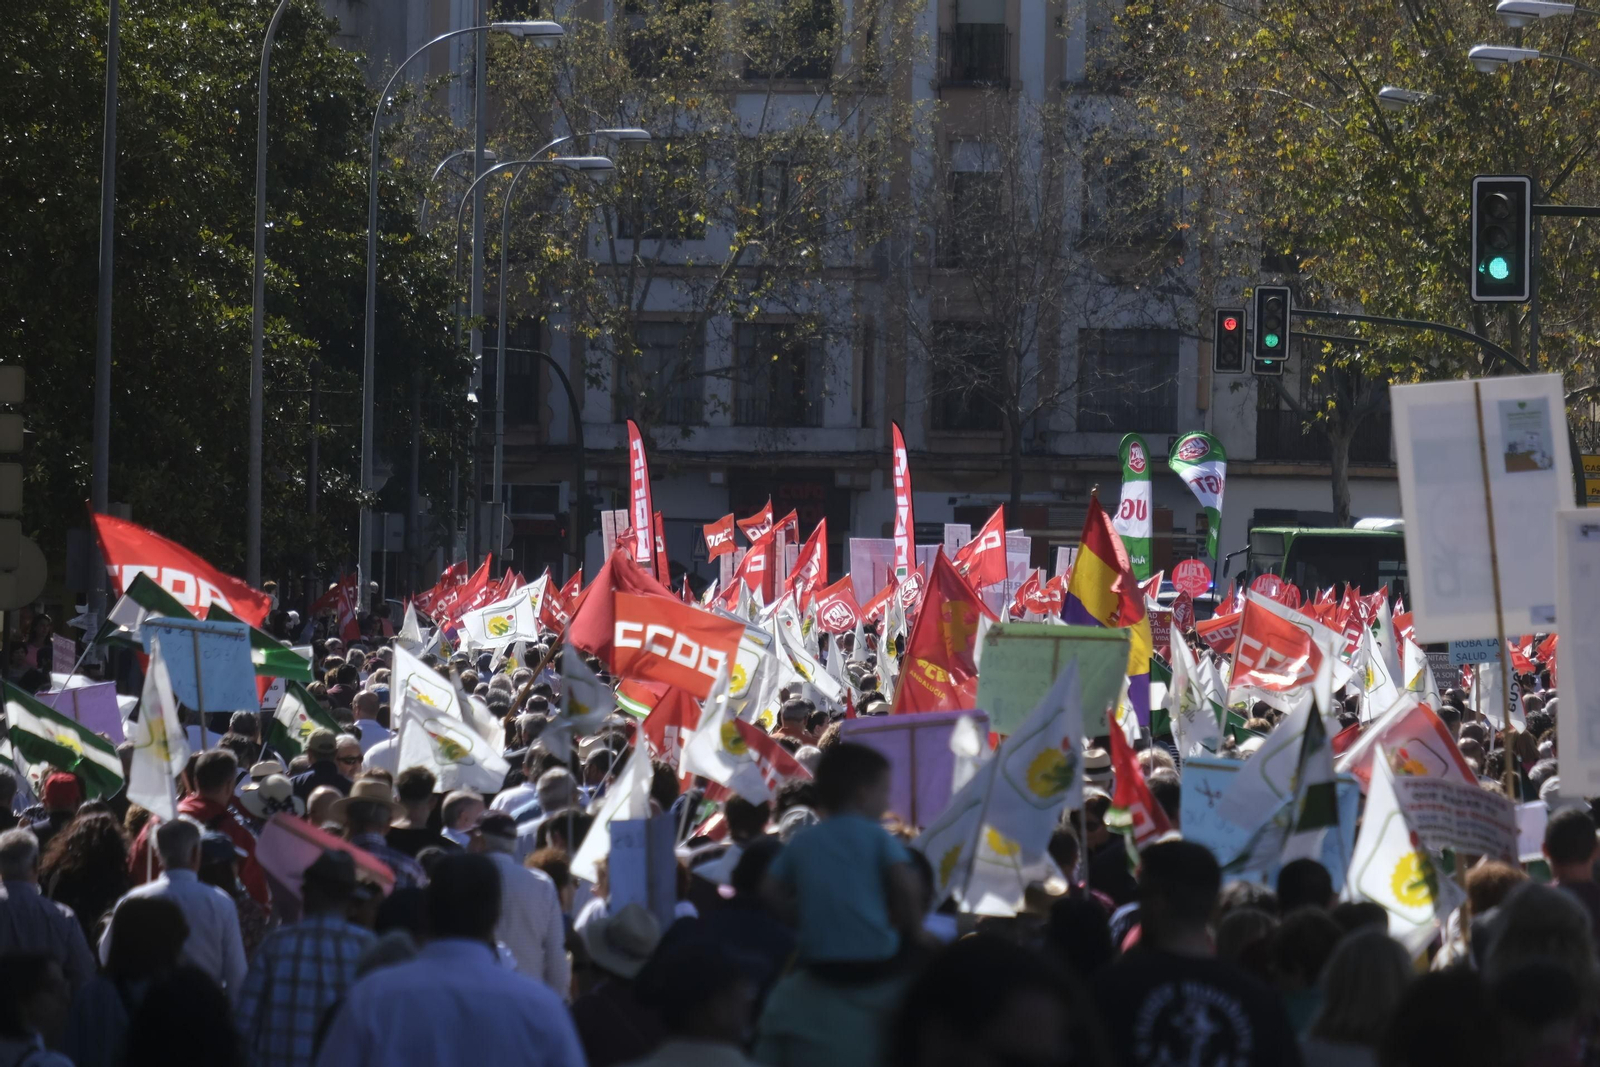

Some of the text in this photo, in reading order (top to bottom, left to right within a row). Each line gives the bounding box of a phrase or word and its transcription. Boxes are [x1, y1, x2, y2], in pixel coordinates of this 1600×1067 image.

[1179, 564, 1206, 578] UGT
[1455, 639, 1500, 648] ROBA LA
[614, 620, 728, 680] CCOO
[1456, 652, 1487, 661] SALUD
